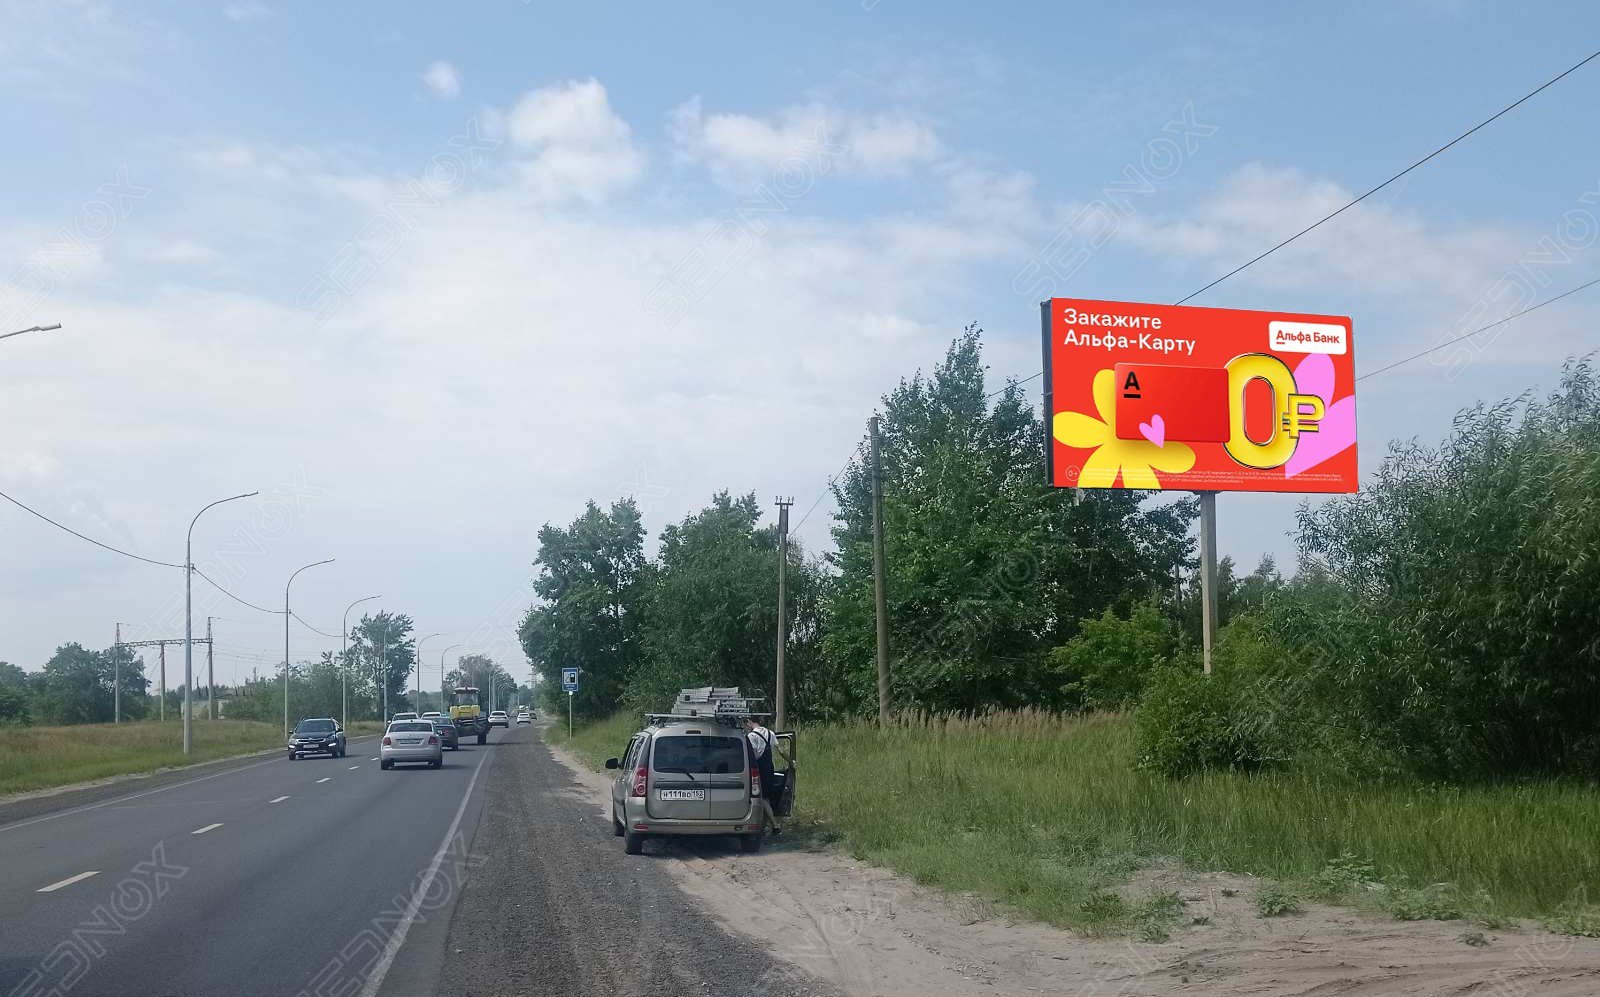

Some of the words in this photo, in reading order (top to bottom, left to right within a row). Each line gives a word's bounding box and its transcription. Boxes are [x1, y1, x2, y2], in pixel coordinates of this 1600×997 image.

[1064, 308, 1162, 330] Закажите
[1064, 329, 1196, 355] Альфа-Карту
[1276, 329, 1311, 343] Альфа
[1313, 331, 1340, 344] Банк
